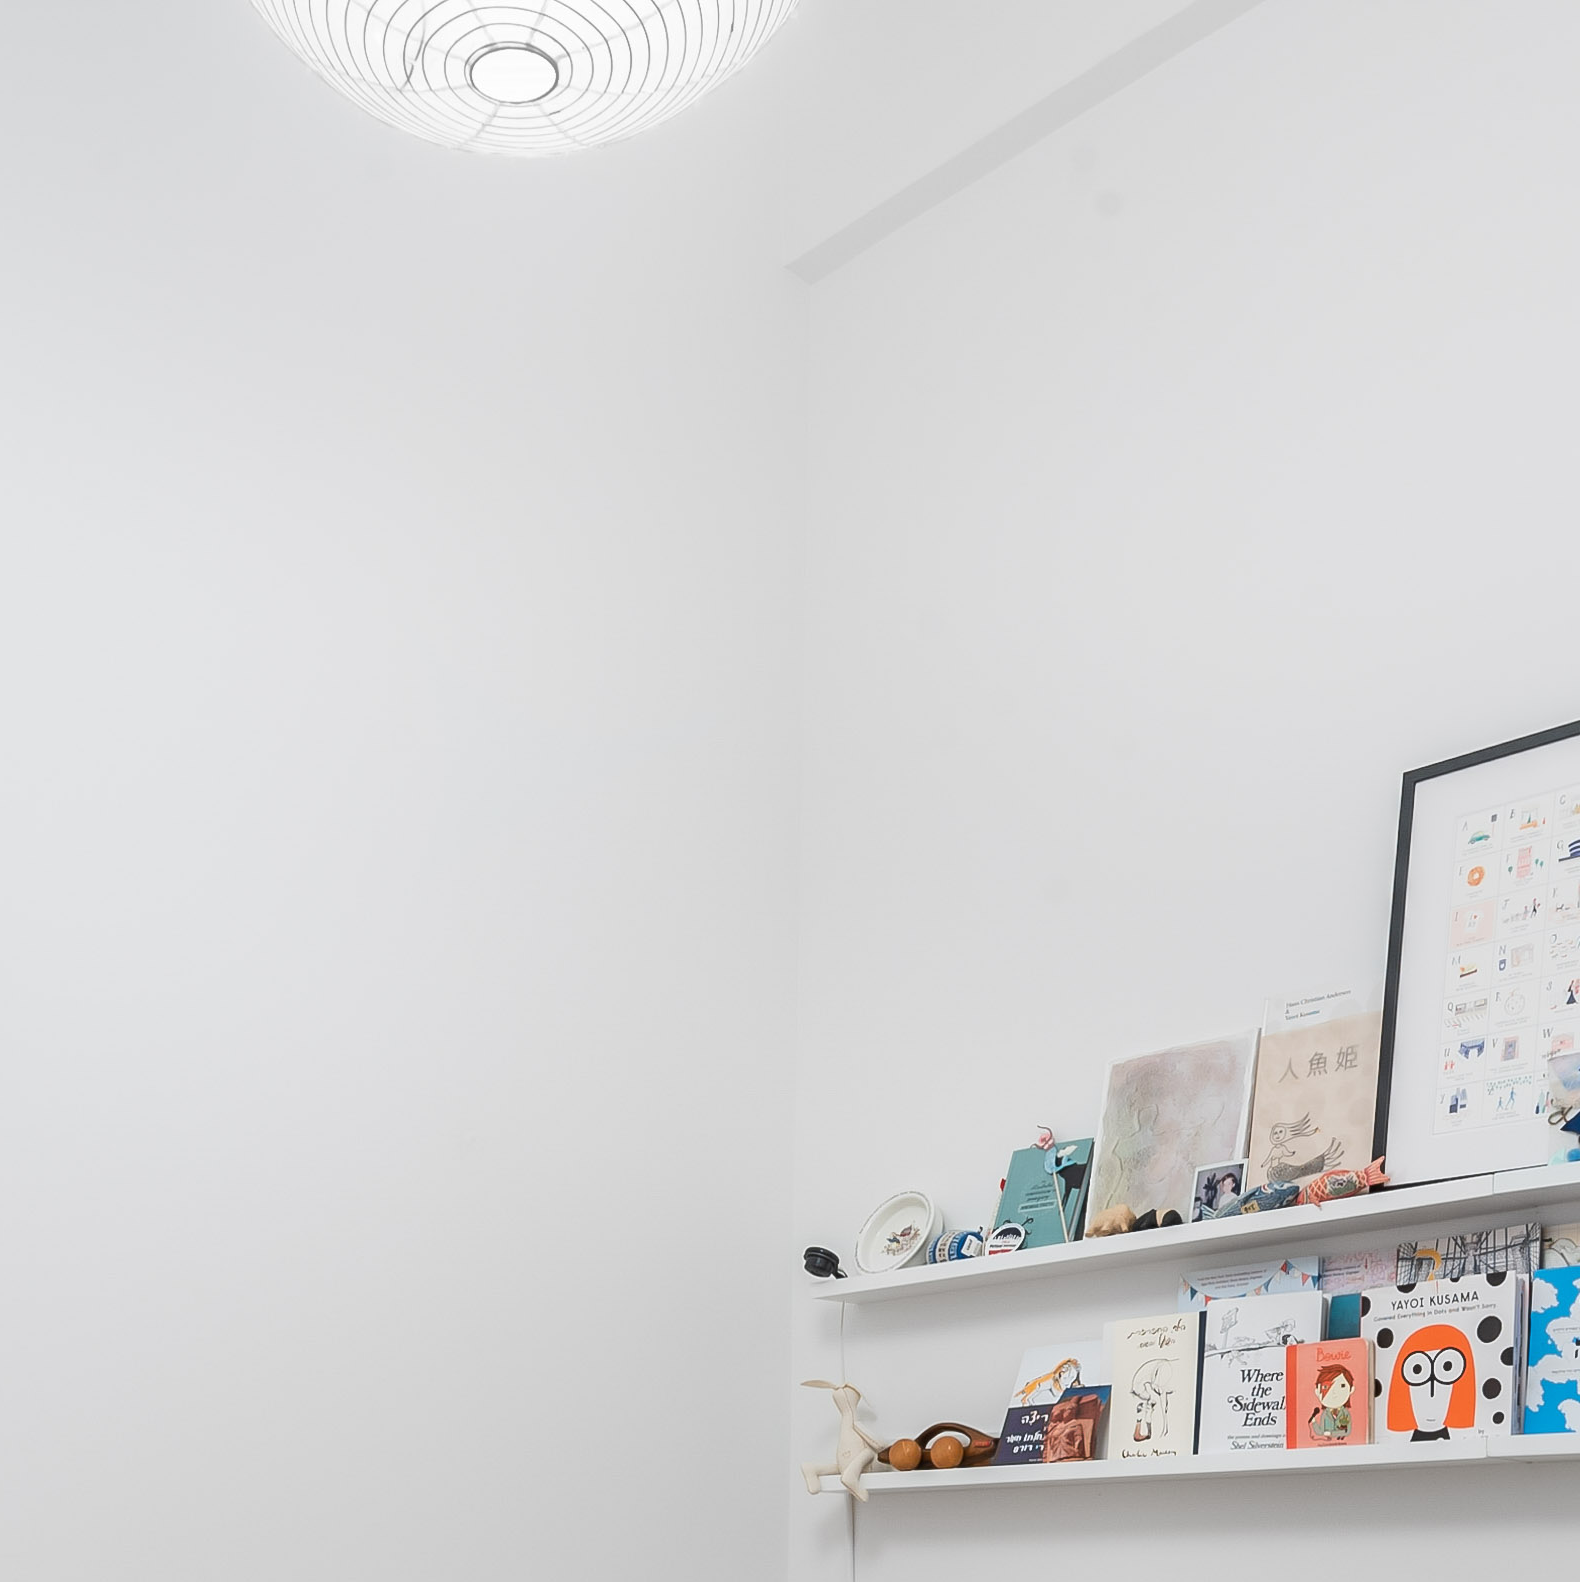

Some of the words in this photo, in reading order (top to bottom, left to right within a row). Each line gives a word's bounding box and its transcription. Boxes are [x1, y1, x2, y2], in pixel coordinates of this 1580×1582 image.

[1391, 1297, 1424, 1311] YAYOI
[1429, 1290, 1479, 1306] KUSAMA
[1316, 1347, 1351, 1362] Bowie
[1240, 1369, 1283, 1383] Where
[1251, 1383, 1272, 1396] the
[1227, 1393, 1286, 1413] Sidewal
[1242, 1412, 1277, 1427] Ends
